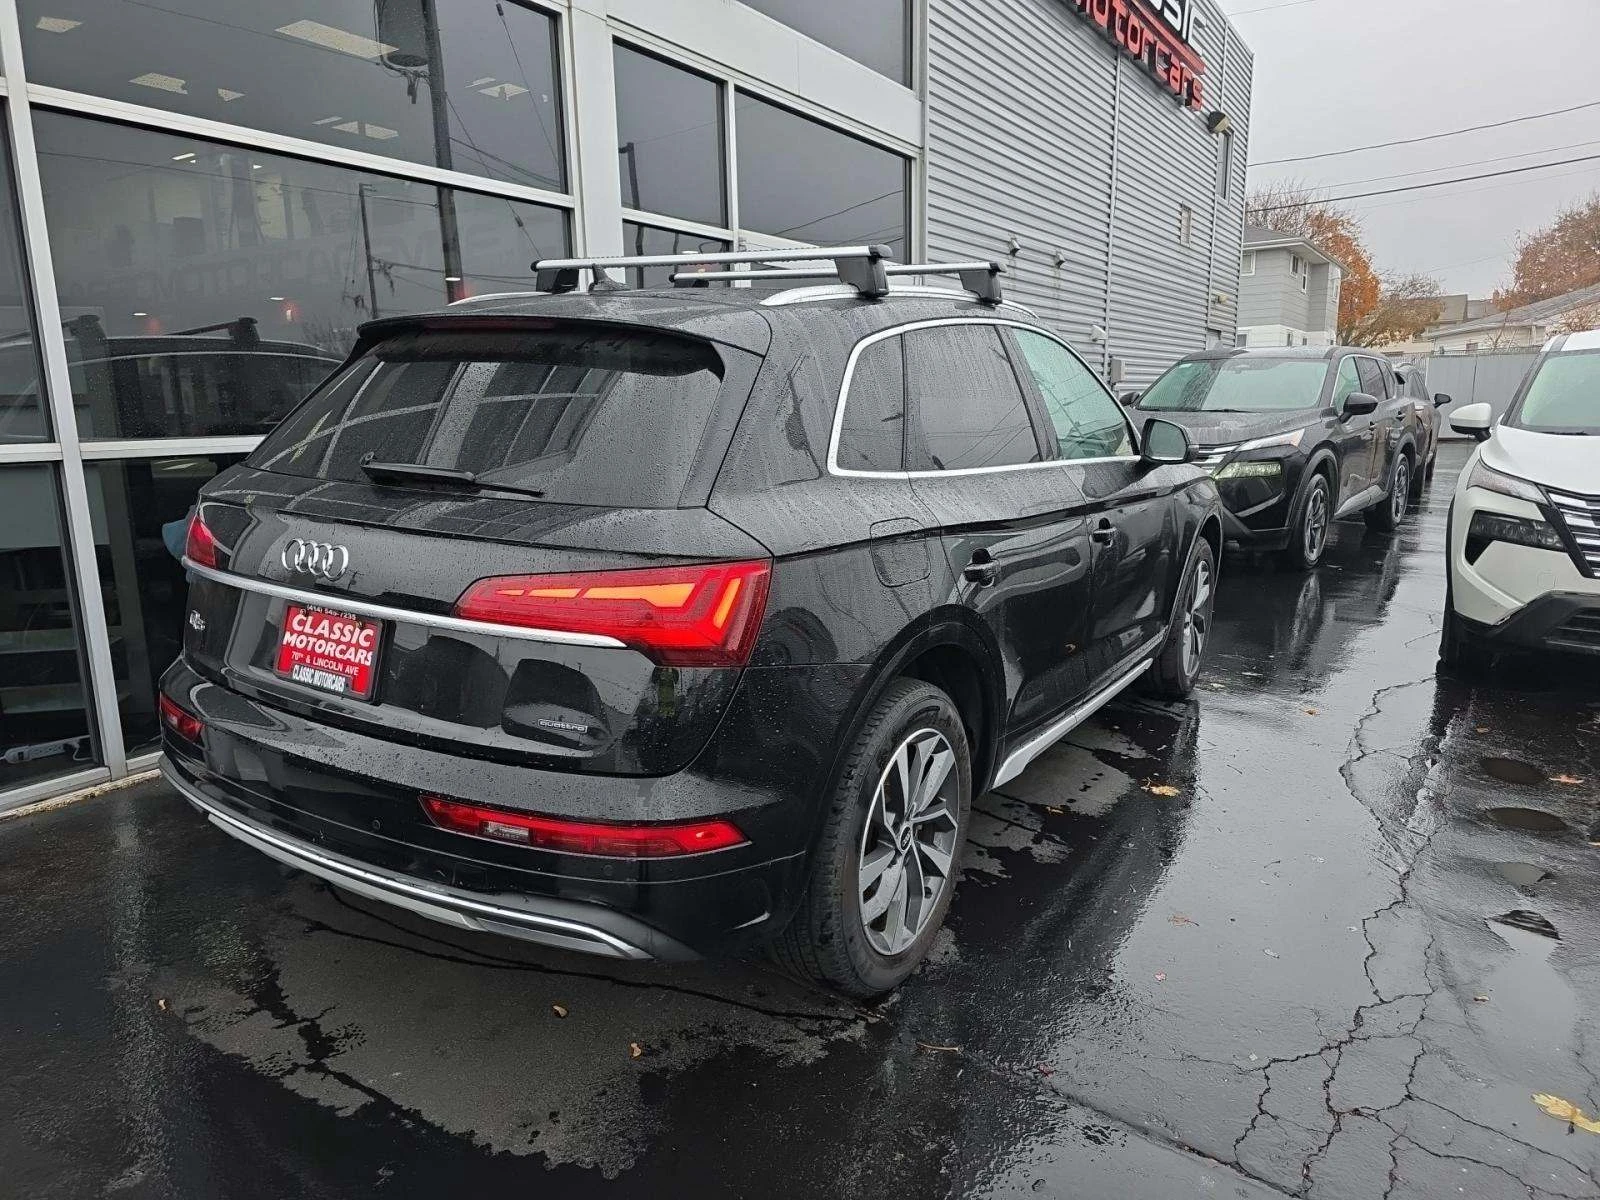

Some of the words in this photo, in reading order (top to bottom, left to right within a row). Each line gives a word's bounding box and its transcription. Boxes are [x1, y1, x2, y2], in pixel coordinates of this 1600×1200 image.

[292, 614, 373, 647] CLASSIC
[283, 631, 373, 666] MOTORCARS
[293, 664, 314, 684] CLASSIC
[314, 670, 346, 692] MOTORCARS
[306, 655, 311, 663] &
[313, 657, 343, 671] LINCOLN
[345, 665, 359, 676] AVE
